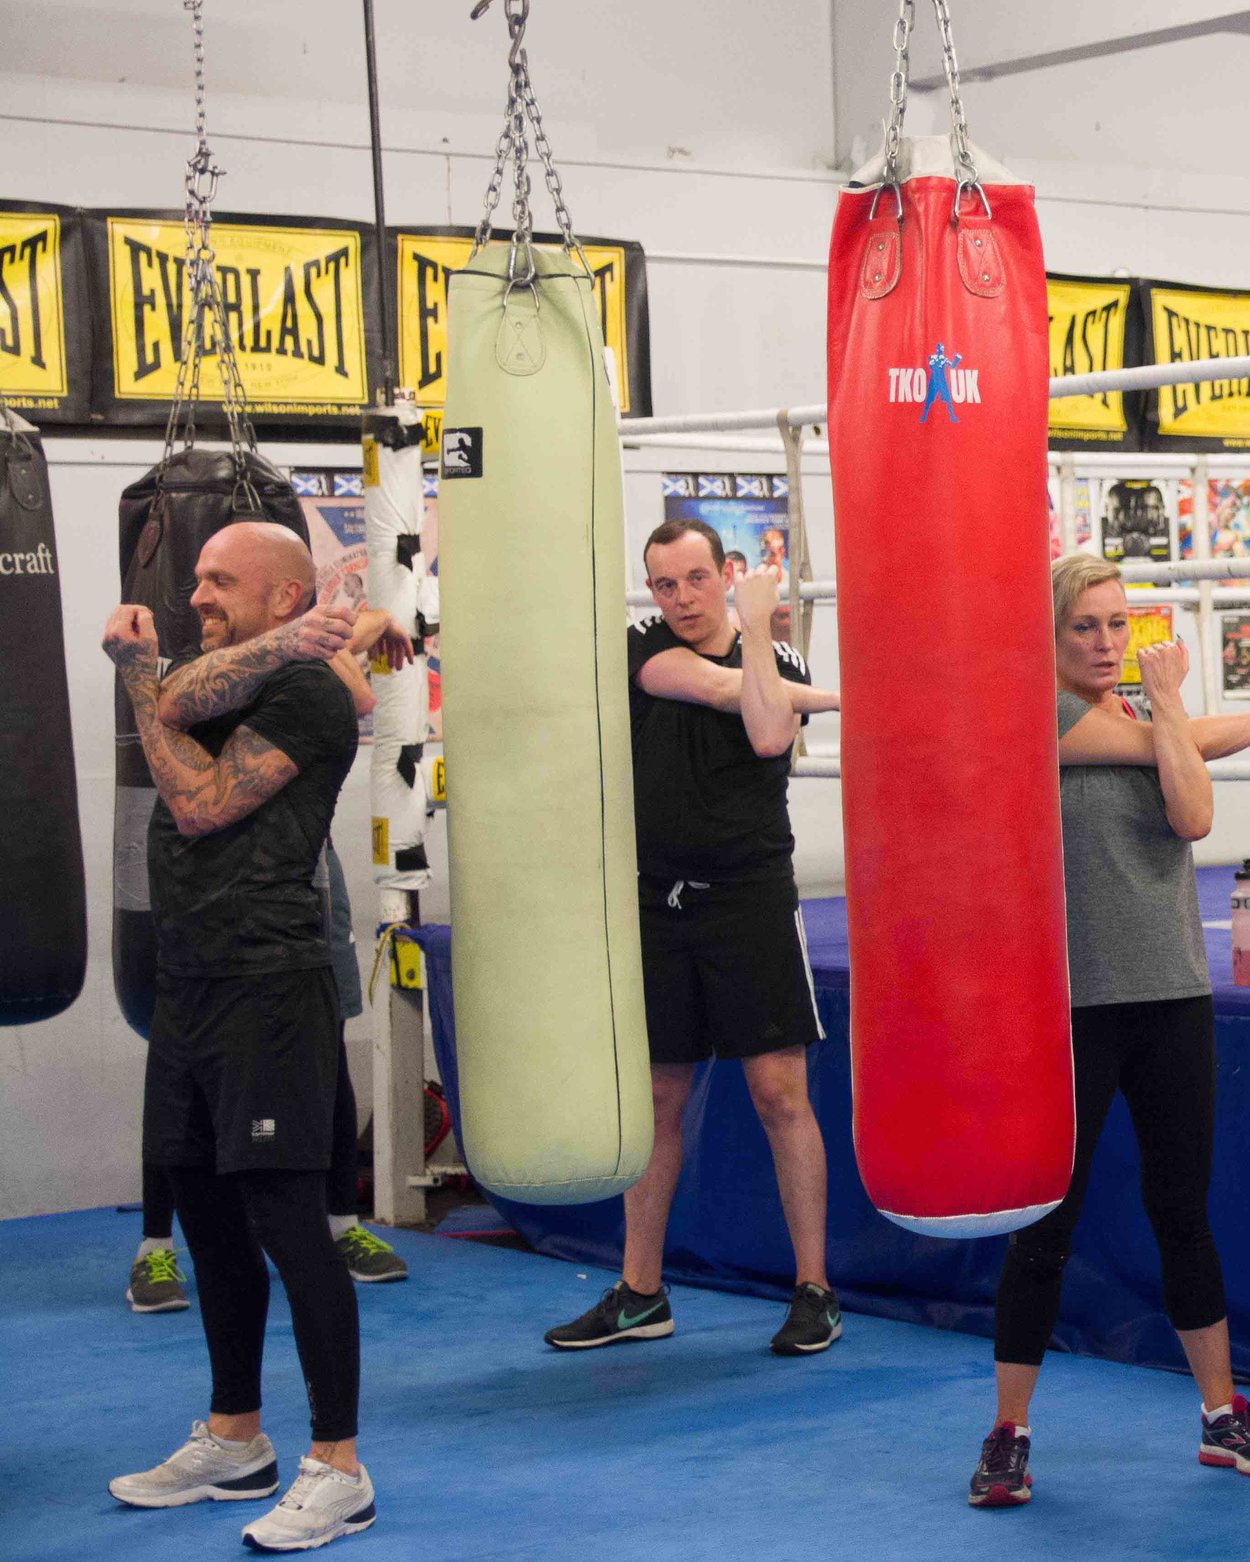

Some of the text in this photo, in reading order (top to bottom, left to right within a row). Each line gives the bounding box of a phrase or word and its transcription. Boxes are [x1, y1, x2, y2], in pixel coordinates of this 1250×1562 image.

[124, 235, 349, 382] EVERLAST
[888, 367, 981, 404] TKO UK
[0, 542, 54, 575] craft
